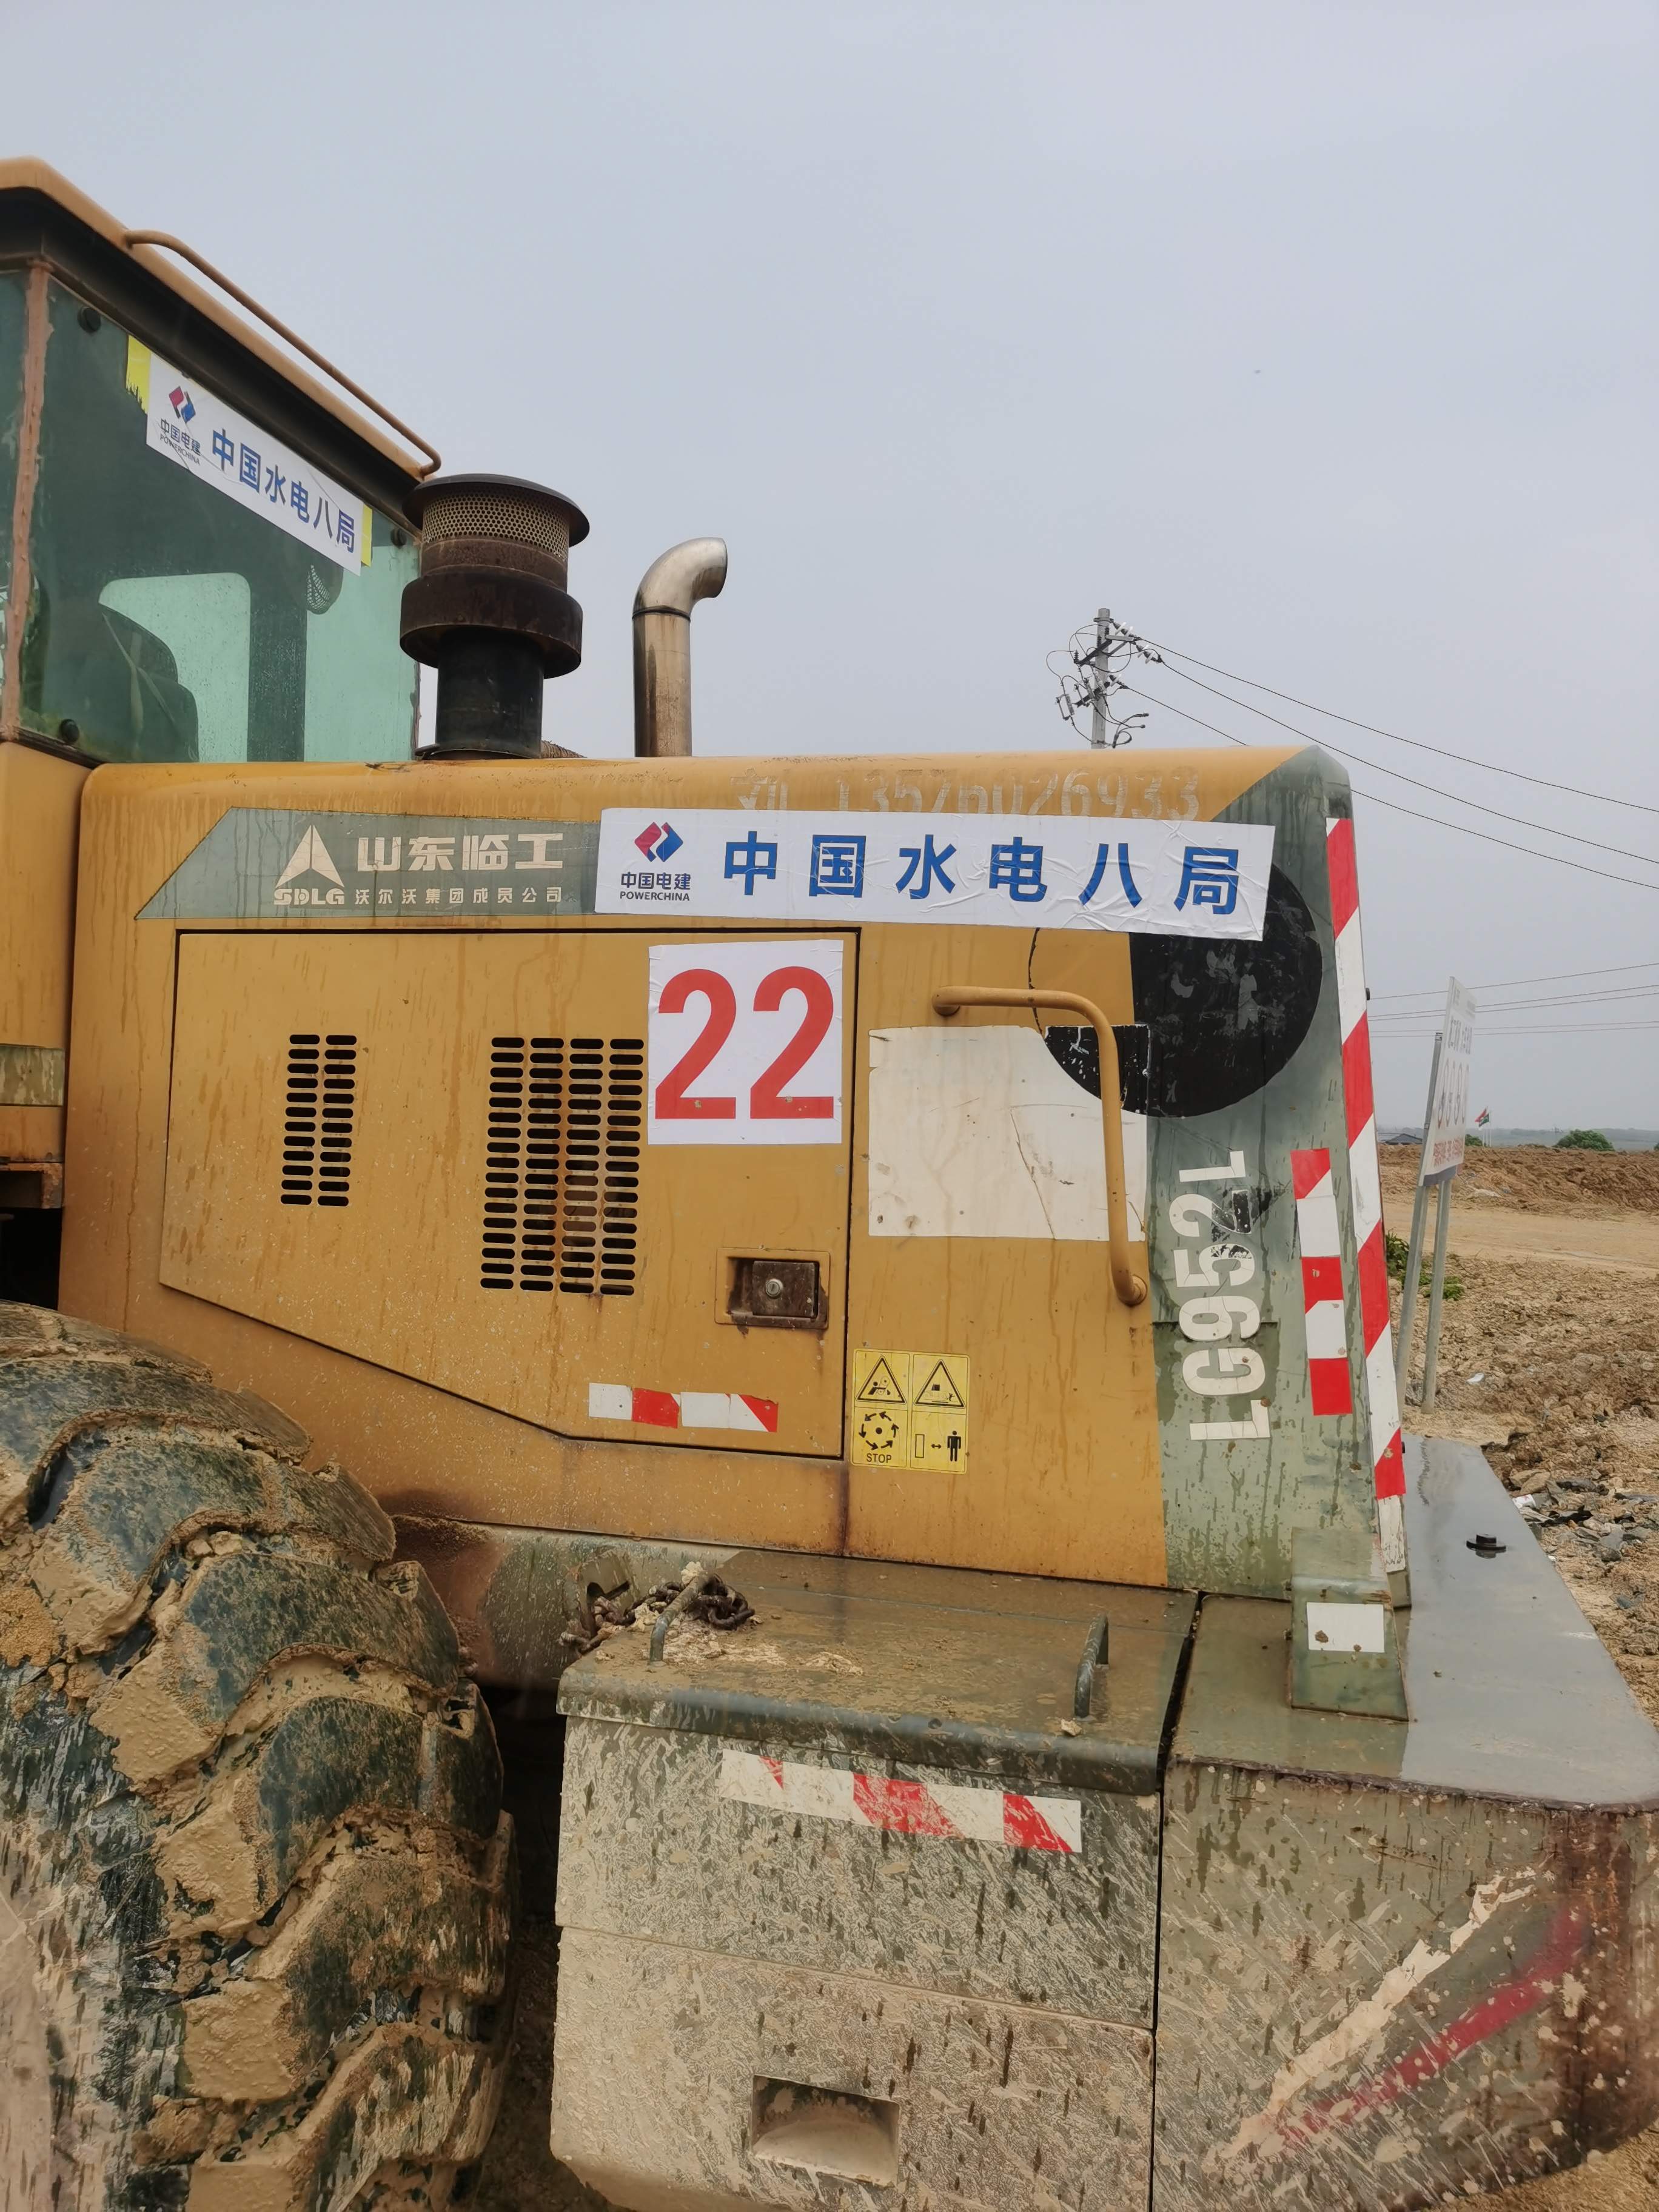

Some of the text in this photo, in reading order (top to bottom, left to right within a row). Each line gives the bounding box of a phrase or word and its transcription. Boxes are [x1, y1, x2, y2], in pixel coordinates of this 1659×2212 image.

[160, 418, 201, 456] 中国电建
[212, 429, 355, 554] 中国水电八局
[357, 833, 563, 872] 山东临工
[620, 871, 691, 890] 中国电建
[724, 830, 1239, 915] 中国水电八局
[273, 888, 345, 905] SDLG
[355, 886, 562, 905] 沃尔沃集团成员公司
[619, 891, 690, 902] POWERCHINA
[655, 966, 834, 1120] 22
[1168, 1150, 1270, 1441] LG952L
[866, 1453, 893, 1464] STOP
